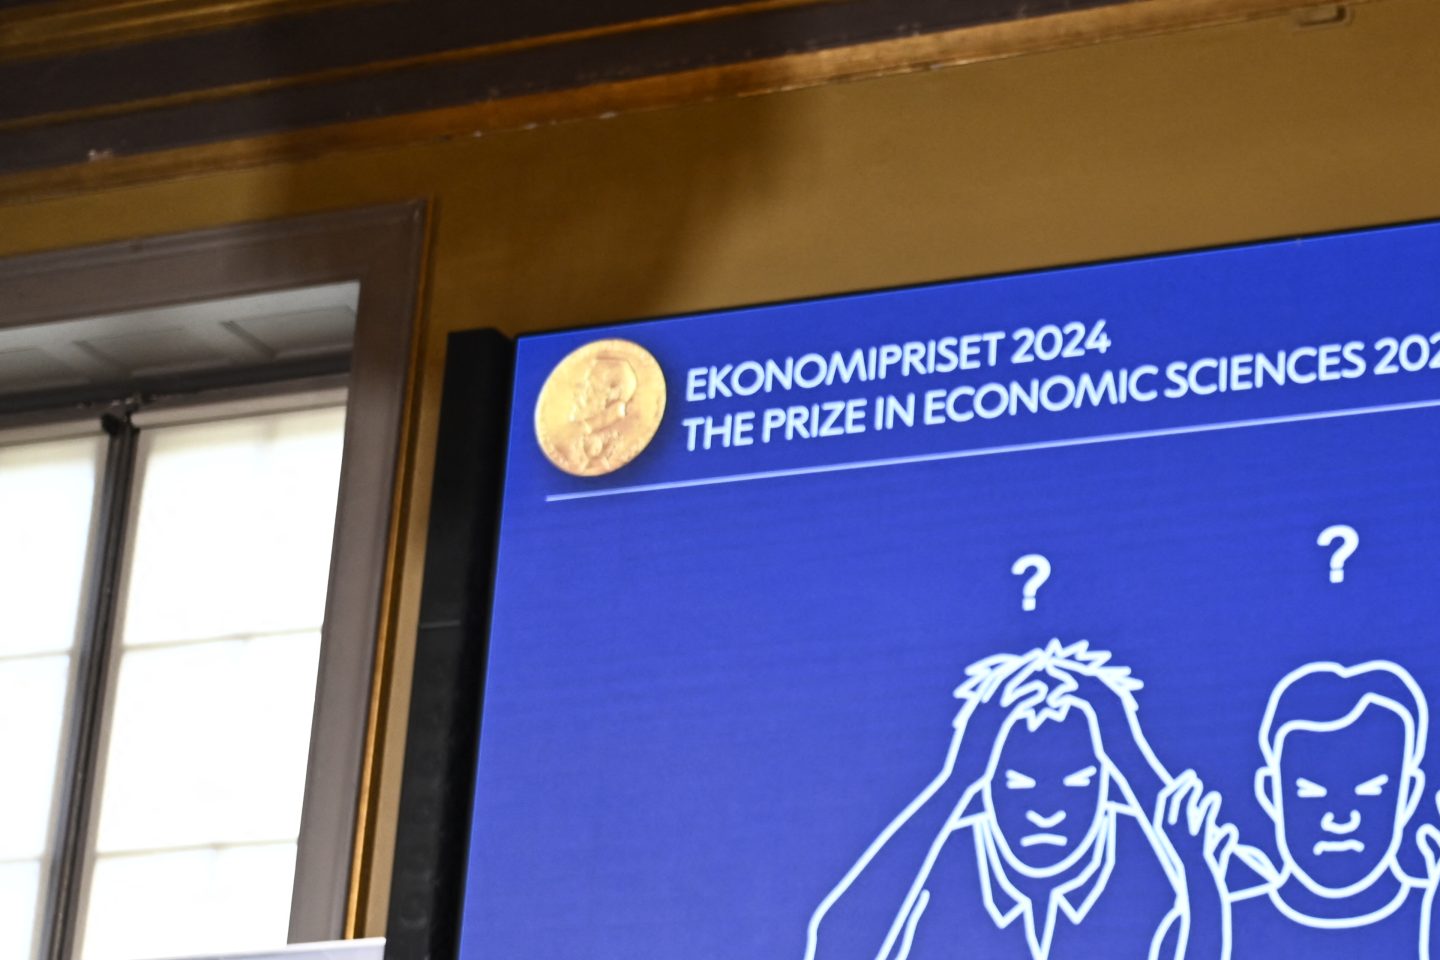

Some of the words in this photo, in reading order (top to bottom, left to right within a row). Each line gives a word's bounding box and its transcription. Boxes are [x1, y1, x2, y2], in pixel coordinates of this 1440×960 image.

[686, 331, 1006, 401] EKONOMIPRISET
[1011, 318, 1111, 364] 2024
[682, 411, 755, 451] THE
[762, 398, 867, 443] PRIZE
[874, 392, 915, 431] IN
[924, 364, 1159, 425] ECONOMIC
[1163, 340, 1367, 398] SCIENCES
[1011, 554, 1051, 612] ?
[1316, 524, 1359, 583] ?
